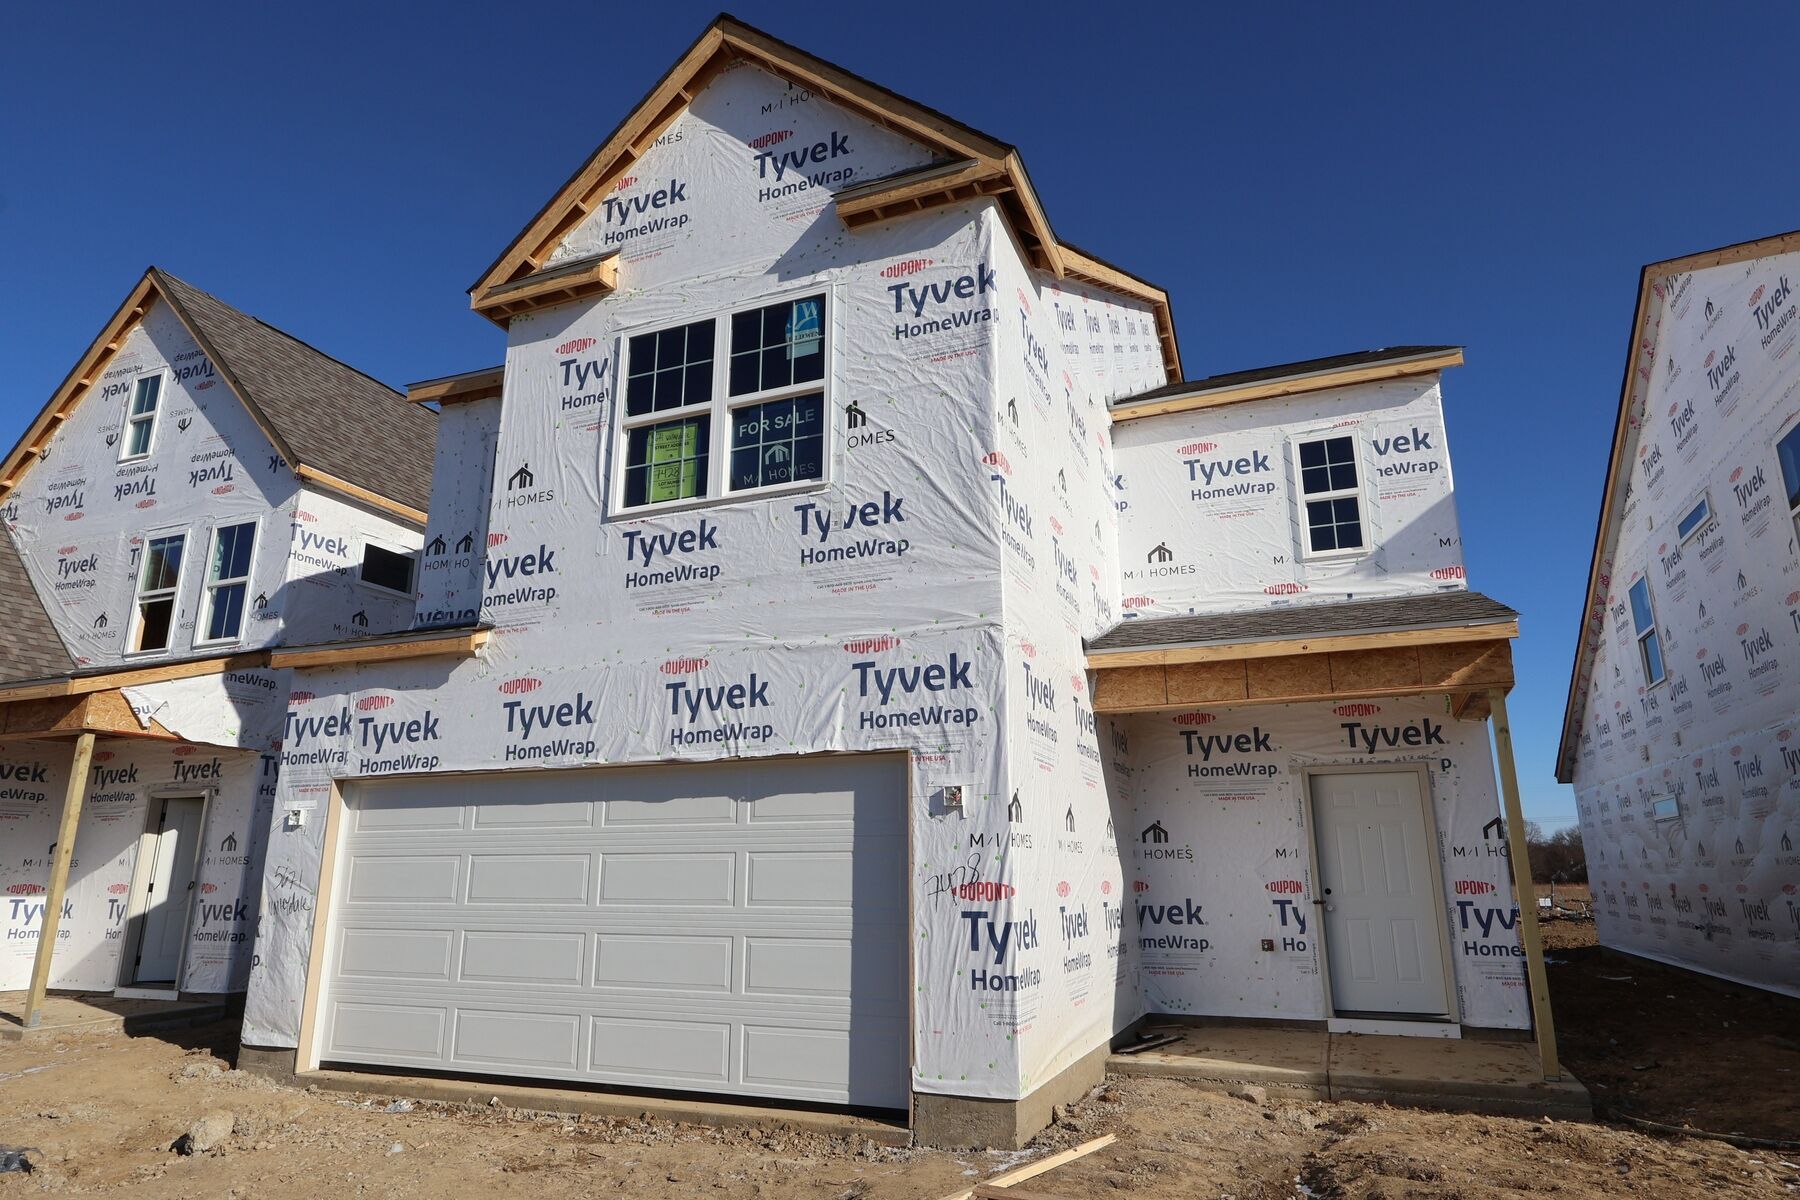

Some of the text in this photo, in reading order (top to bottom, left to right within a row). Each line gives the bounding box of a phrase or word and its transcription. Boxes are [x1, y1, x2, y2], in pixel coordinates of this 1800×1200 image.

[649, 131, 683, 149] MES
[753, 130, 788, 149] DUPONT
[754, 131, 849, 182] Tyvek
[759, 167, 853, 202] HomeWrap
[602, 179, 687, 225] Tyvek
[605, 213, 689, 245] HomeWrap
[887, 258, 928, 278] DUPONT
[887, 263, 998, 318] Tyvek
[1753, 275, 1792, 330] Tyvek
[1761, 305, 1797, 350] HomeWrap
[560, 337, 592, 354] DUPONT
[1020, 308, 1050, 379] Tyvek
[173, 358, 215, 385] Tyvek
[560, 358, 609, 391] Tyv
[1707, 344, 1736, 391] Tyvek
[562, 388, 609, 410] Home
[739, 408, 816, 438] FOR SALE
[1065, 387, 1087, 442] Tyvek
[1670, 399, 1696, 439] Tyvek
[847, 429, 895, 449] OMES
[1181, 442, 1214, 455] DUPONT
[1372, 427, 1432, 456] vek
[192, 448, 235, 463] HomeWrap
[1183, 450, 1271, 486] Tyvek
[1642, 443, 1663, 478] Tyvek
[190, 463, 234, 487] Tyvek
[769, 462, 816, 481] HOMES
[114, 475, 156, 501] Tyvek
[508, 489, 554, 508] HOMES
[1191, 480, 1276, 501] HomeWrap
[1734, 465, 1766, 508] Tyvek
[46, 489, 84, 514] Tyvek
[991, 474, 1032, 539] Tyvek
[290, 522, 348, 559] Tyvek
[622, 519, 718, 568] Tyvek
[801, 538, 909, 565] HomeWrap
[1001, 523, 1035, 572] HomeWrap
[1439, 536, 1462, 548] M/I
[57, 554, 98, 580] Tyvek
[289, 550, 348, 576] HomeWrap
[1052, 537, 1078, 585] Tyvek
[1124, 564, 1196, 580] M/I HOMES
[1661, 543, 1682, 576] Tyvek
[55, 578, 96, 592] HomeWrap
[626, 564, 720, 589] HomeWrap
[1268, 582, 1304, 595] DUPONT
[1124, 597, 1150, 609] UPONT
[850, 636, 894, 654] DUPONT
[1741, 627, 1774, 662] Tyvek
[664, 658, 704, 675] DUPONT
[1700, 650, 1727, 682] Tyvek
[226, 672, 277, 690] meWrap
[503, 677, 538, 695] DUPONT
[851, 652, 973, 706] Tyvek
[1023, 662, 1056, 712] Tyvek
[359, 695, 390, 711] DUPONT
[666, 673, 769, 724] Tyvek
[1338, 704, 1376, 717] DUPONT
[284, 707, 350, 747] Tyvek
[503, 692, 593, 740] Tyvek
[859, 705, 979, 731] HomeWrap
[1178, 713, 1212, 726] DUPONT
[359, 711, 440, 754] Tyvek
[671, 722, 773, 746] HomeWrap
[1179, 727, 1272, 762] Tyvek
[1341, 718, 1446, 755] Tyvek
[505, 738, 595, 761] HomeWrap
[0, 762, 48, 783] vek
[93, 763, 138, 790] Tyvek
[173, 757, 221, 783] Tyvek
[360, 754, 439, 774] HomeWrap
[1188, 762, 1277, 779] HomeWrap
[1733, 754, 1763, 784] Tyvek
[0, 788, 45, 803] eWrap
[90, 789, 137, 805] HomeWrap
[970, 832, 1000, 848] M/I
[1453, 846, 1478, 858] M/I
[219, 856, 250, 865] HOMES
[1144, 847, 1193, 860] HOMES
[1276, 848, 1298, 859] M/I
[11, 884, 41, 894] DUPONT
[959, 881, 1009, 902] DUPONT
[1271, 880, 1302, 894] DUPON
[1454, 880, 1490, 895] UPONT
[1456, 901, 1519, 938] Tyv
[1740, 898, 1770, 923] Tyvek
[961, 908, 1038, 965] Tyvek
[1059, 903, 1089, 950] Tyvek
[1141, 935, 1209, 952] meWrap
[1463, 941, 1521, 957] Home
[971, 967, 1041, 992] HomeWrap
